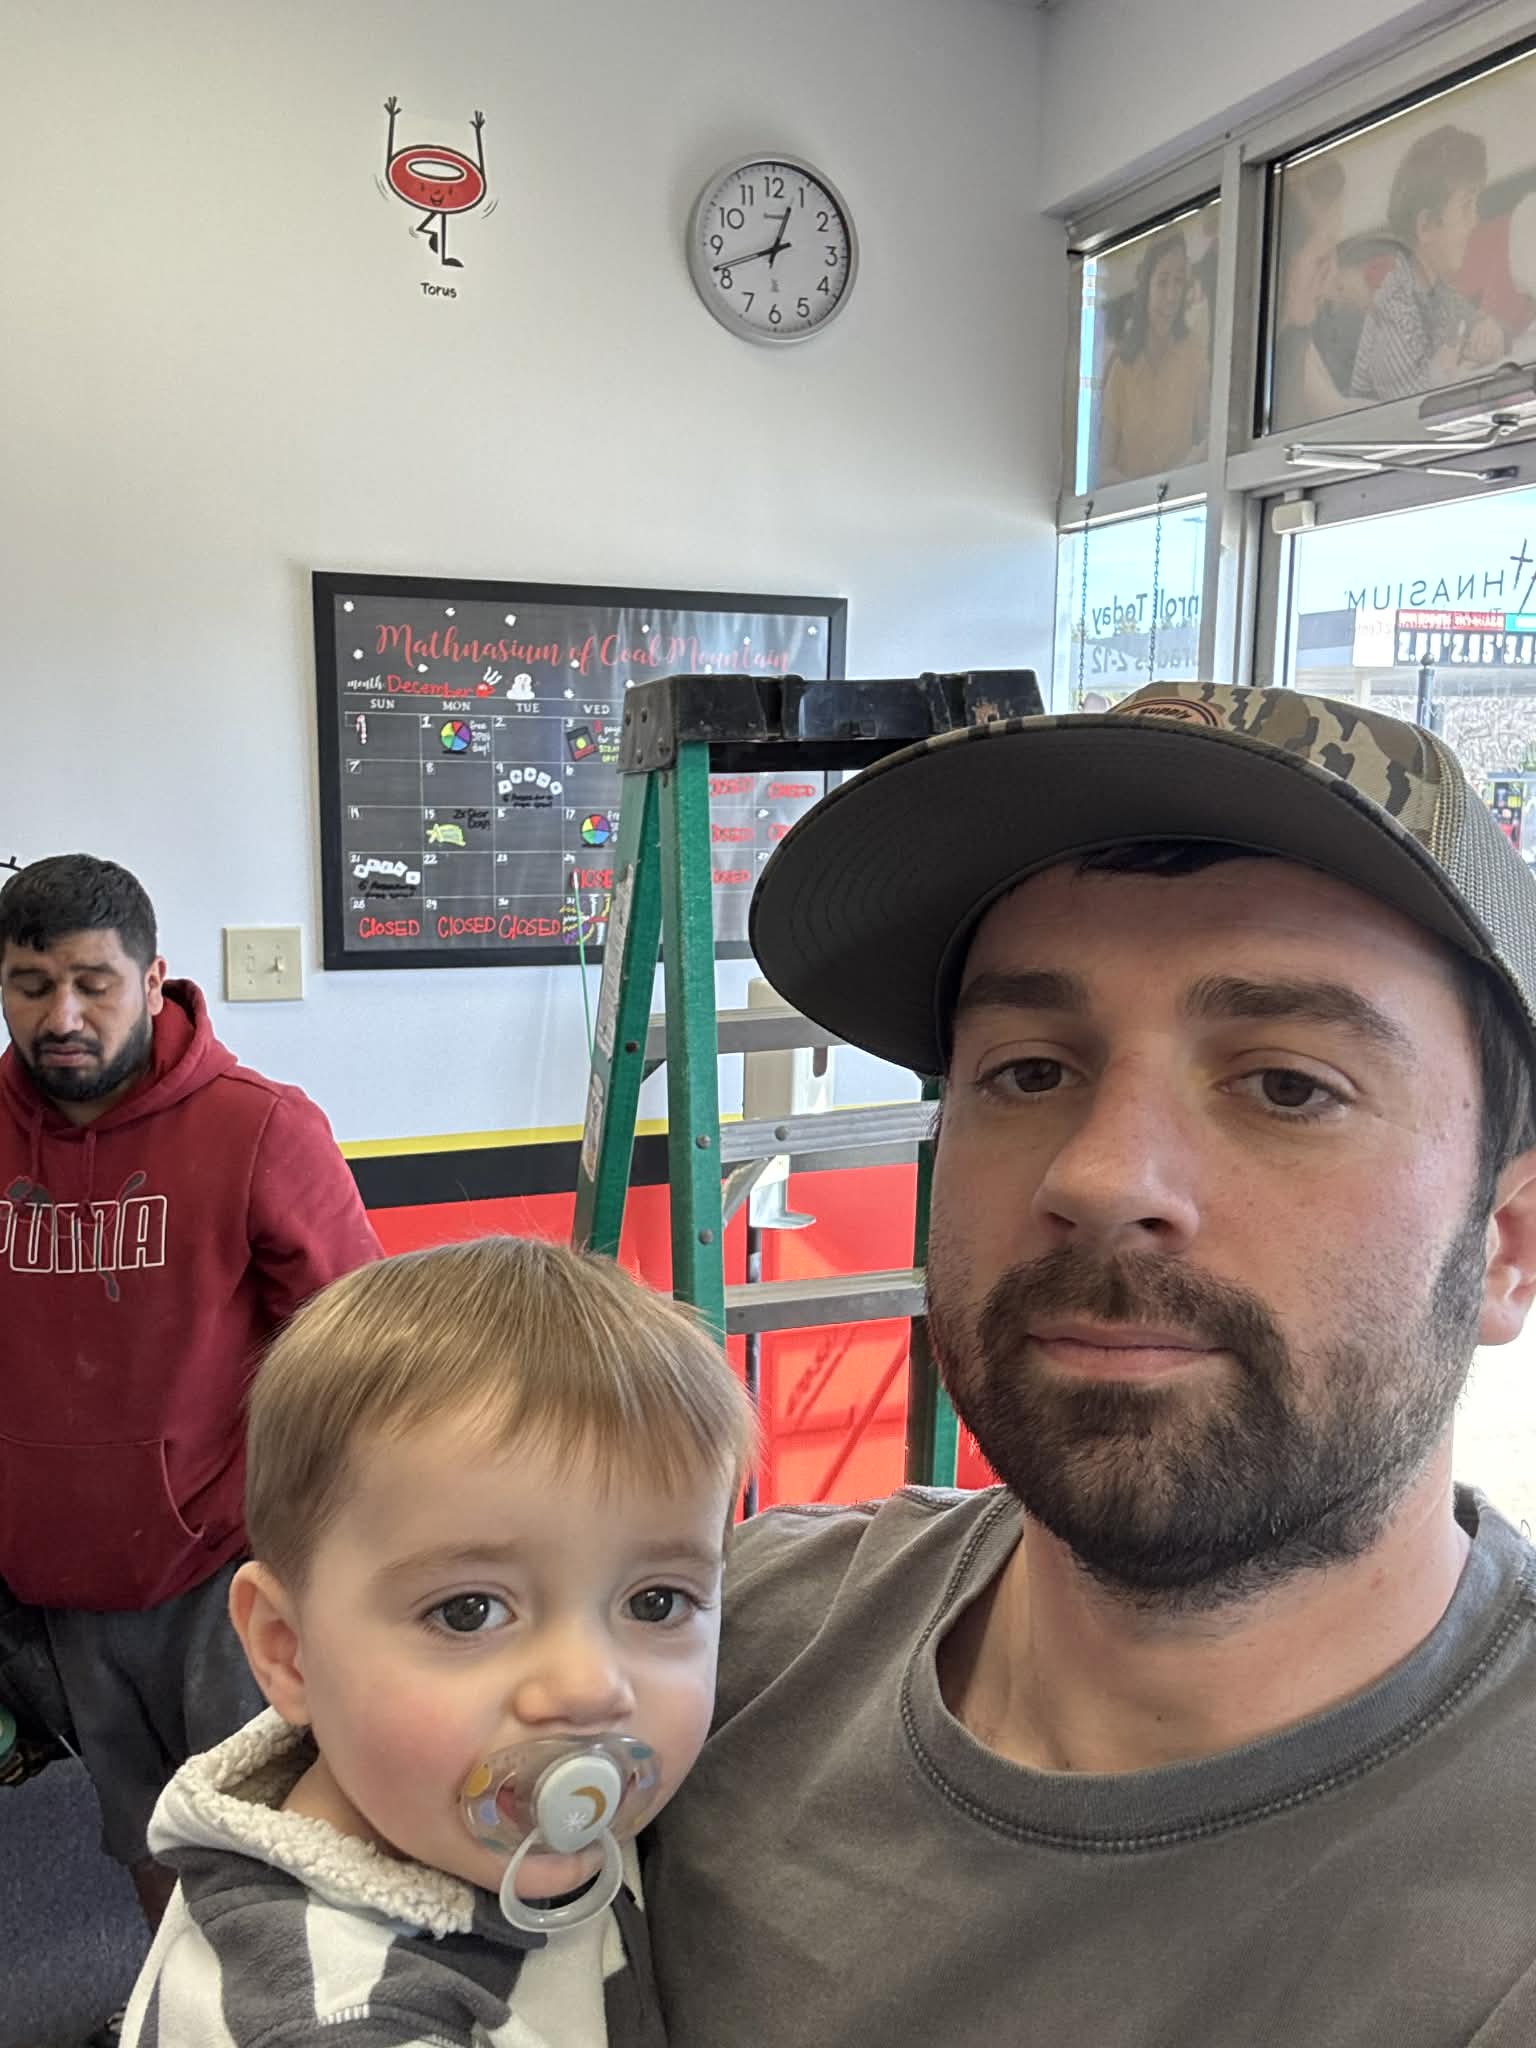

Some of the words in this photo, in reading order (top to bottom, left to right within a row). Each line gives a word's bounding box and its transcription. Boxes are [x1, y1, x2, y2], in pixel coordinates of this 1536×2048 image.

[740, 184, 754, 206] 11
[764, 176, 784, 199] 12
[719, 207, 745, 230] 10
[816, 211, 829, 232] 2
[710, 234, 724, 255] 9
[824, 246, 838, 267] 3
[720, 268, 733, 289] 8
[816, 276, 830, 295] 4
[420, 282, 457, 298] Torus
[741, 292, 755, 312] 7
[796, 297, 810, 318] 5
[768, 304, 782, 324] 6
[376, 624, 561, 667] Mathnasium
[568, 635, 595, 676] of
[600, 634, 661, 668] Coal
[387, 674, 474, 698] December
[370, 698, 395, 709] SUN
[442, 701, 471, 711] MON
[515, 703, 540, 713] TUE
[0, 1196, 167, 1274] UMA
